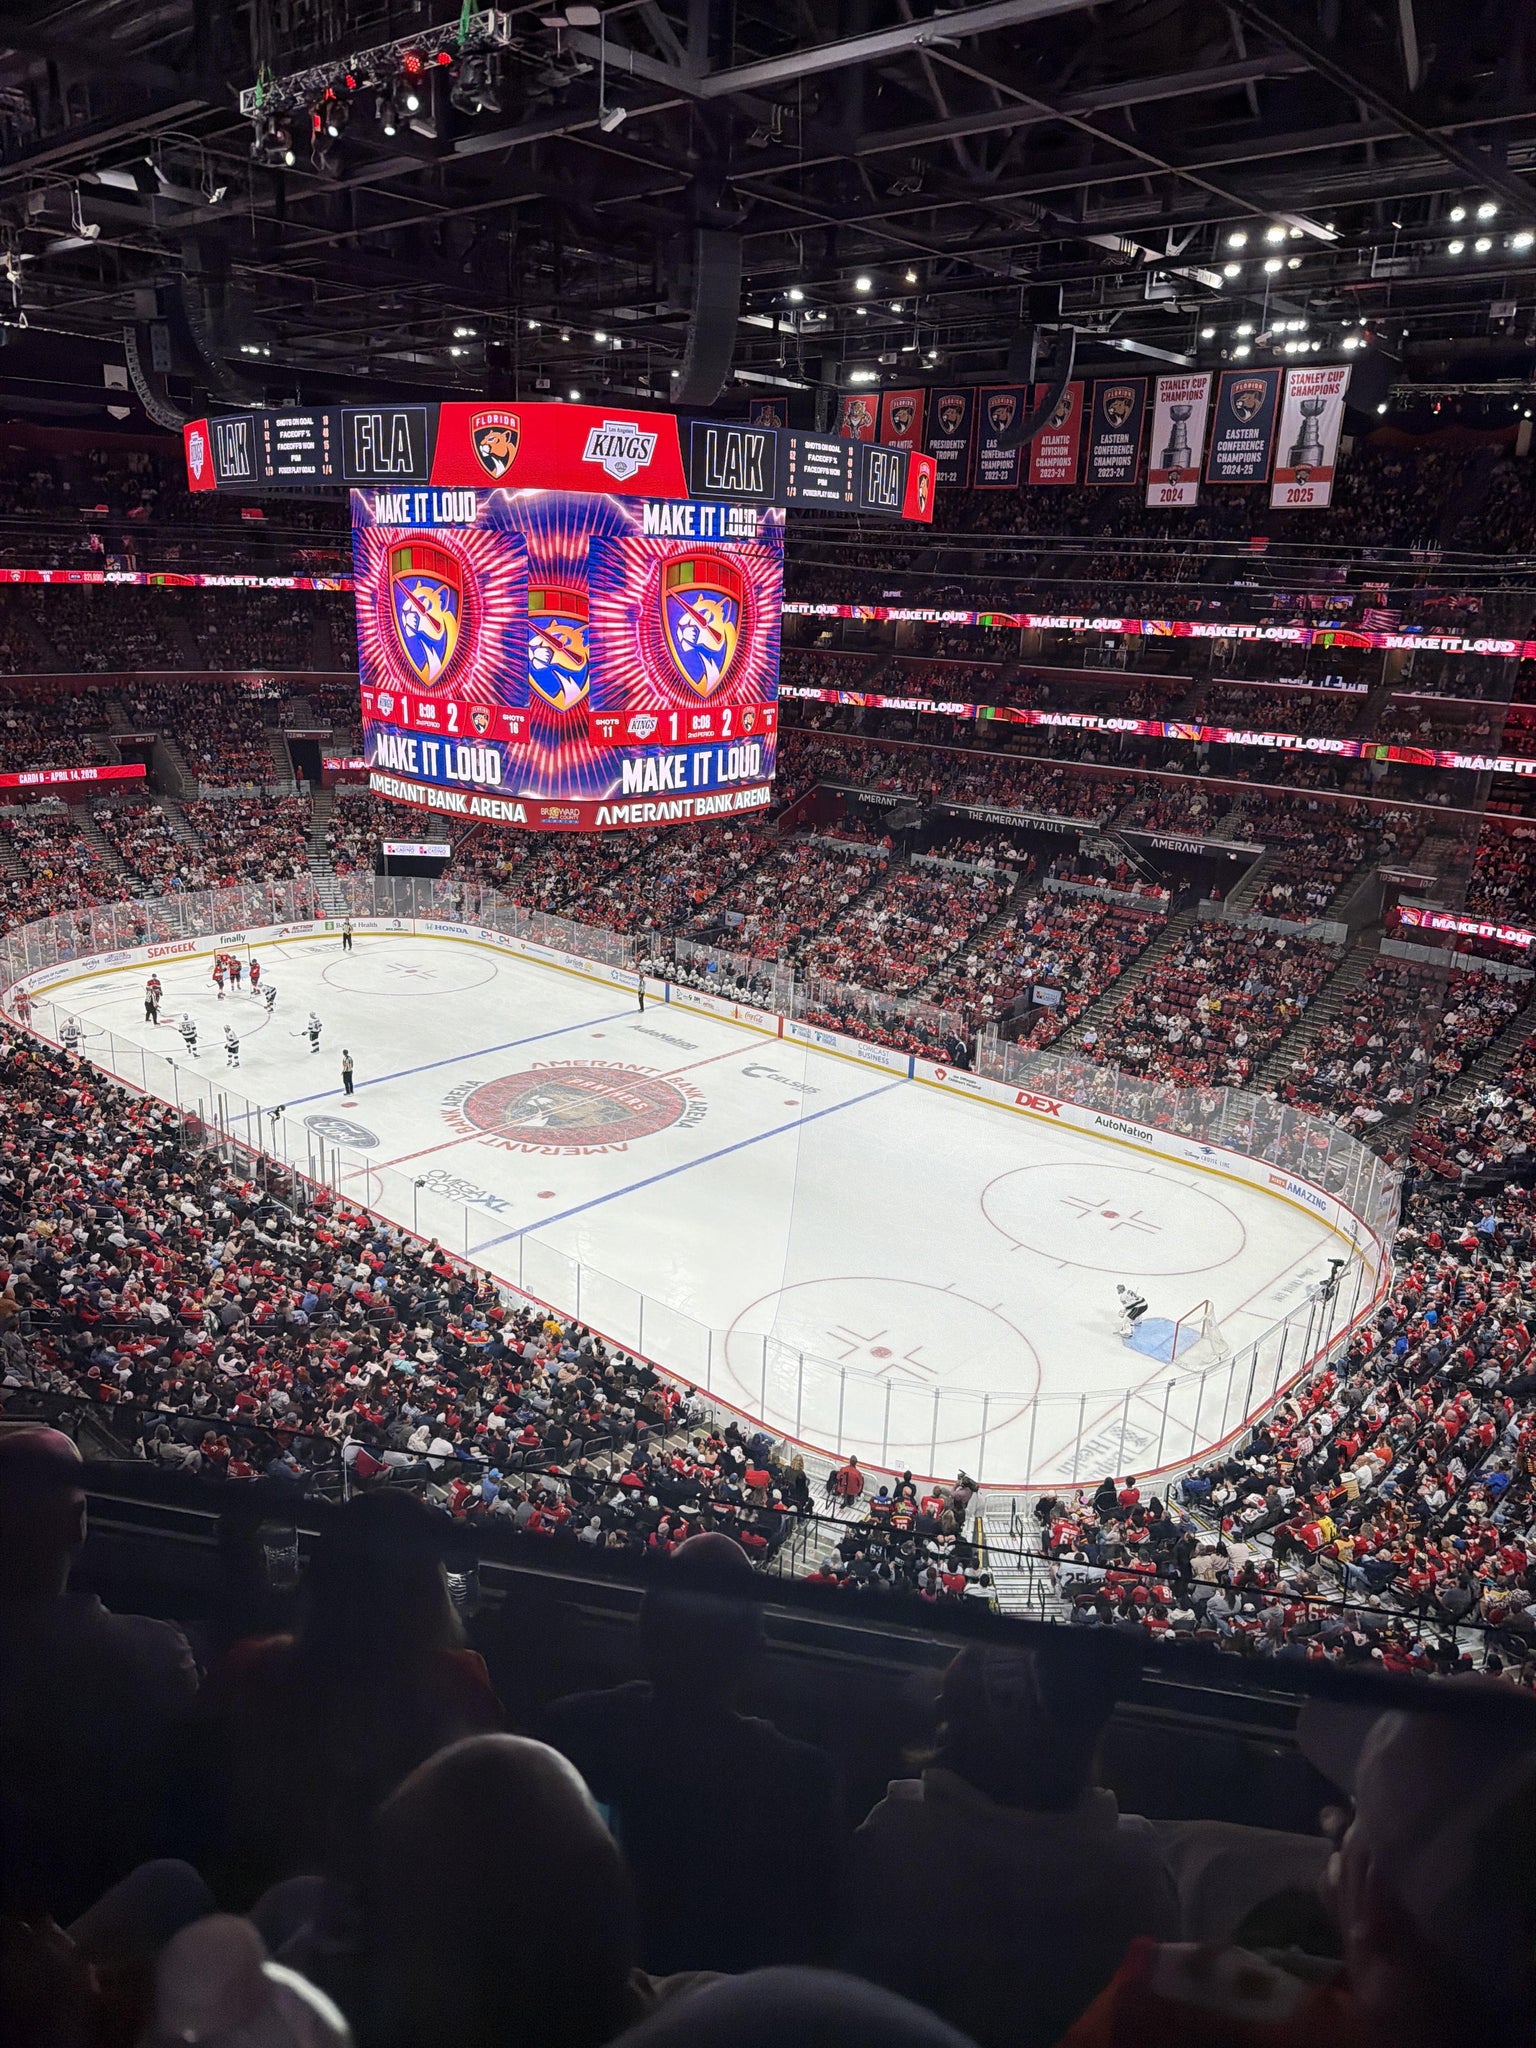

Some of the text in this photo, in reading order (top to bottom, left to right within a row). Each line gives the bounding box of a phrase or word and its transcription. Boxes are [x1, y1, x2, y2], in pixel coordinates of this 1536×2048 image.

[1160, 377, 1207, 392] STANLEY CUP
[1290, 371, 1344, 384] STANLEY CUP
[1233, 381, 1265, 392] FLORIDA
[1291, 384, 1340, 396] CHAMPIONS
[1160, 389, 1204, 402] CHAMPIONS
[475, 414, 516, 428] FLORIDA
[279, 430, 305, 439] FACEOFF
[1041, 435, 1070, 445] ATLANTIC
[1101, 434, 1129, 444] EASTERN
[1226, 428, 1259, 439] EASTERN
[217, 422, 250, 477] LAK
[354, 415, 413, 473] FLA
[592, 434, 650, 460] KINGS
[790, 438, 797, 449] 11
[1041, 445, 1068, 456] DIVISION
[1093, 444, 1134, 455] CONFERENCE
[1217, 440, 1265, 451] CONFERENCE
[705, 430, 765, 491] LAK
[807, 454, 833, 464] FACEOFF
[936, 450, 958, 460] TROPHY
[1036, 456, 1072, 467] CHAMPIONS
[1093, 455, 1131, 466] CHAMPIONS
[1217, 452, 1261, 463] CHAMPIONS
[322, 464, 333, 476] 1/4
[981, 460, 1014, 470] CHAMPIONS
[1221, 464, 1254, 475] 2024-25
[868, 451, 899, 506] FLA
[984, 470, 1008, 480] 2022-23
[1040, 468, 1065, 478] 2023-24
[1097, 467, 1124, 478] 2023-24
[1160, 488, 1184, 502] 2024
[1287, 488, 1314, 503] 2025
[375, 491, 476, 524] MAKE IT LOUD
[643, 503, 695, 536] MAKE
[700, 506, 717, 536] IT
[205, 575, 294, 588] MAKE IT LOUD
[798, 604, 809, 614] IT
[809, 604, 838, 615] LOUD
[888, 610, 968, 622] MAKE IT LOUD
[1029, 617, 1122, 630] MAKE IT LOUD
[1191, 625, 1300, 640] MAKE IT LOUD
[1386, 636, 1515, 653] MAKE IT LOUD
[793, 687, 821, 698] LOUD
[401, 695, 409, 724] 1
[418, 703, 436, 719] 8:08
[882, 697, 964, 713] MAKE IT LOUD
[447, 703, 459, 732] 2
[502, 713, 525, 722] SHOTS
[595, 718, 620, 726] SHOTS
[631, 719, 656, 730] KINGS
[692, 714, 711, 730] 8:08
[721, 709, 732, 737] 2
[1039, 713, 1139, 730] MAKE IT LOUD
[603, 725, 613, 738] 11
[669, 712, 678, 741] 1
[1225, 731, 1344, 751] MAKE IT LOUD
[376, 733, 501, 785] MAKE IT LOUD
[1453, 755, 1513, 772] MAKE
[621, 743, 761, 795] MAKE IT LOUD
[19, 773, 36, 784] CARDI
[50, 771, 71, 783] APRIL
[72, 770, 81, 781] 14,
[369, 771, 528, 824] AMERANT BANK ARENA
[858, 793, 897, 807] AMERANT
[595, 786, 771, 826] AMERANT BANK ARENA
[968, 811, 1066, 834] THE AMERANT VAULT
[1150, 838, 1205, 855] AMERANT
[434, 924, 469, 934] HONDA
[1432, 918, 1496, 936] MAKE IT
[220, 932, 246, 944] finally
[147, 940, 196, 959] SEATGEEK
[67, 1027, 76, 1036] 10
[182, 1024, 192, 1032] 55
[628, 1024, 699, 1051] AutoNation
[858, 1043, 890, 1057] COMCAST
[857, 1050, 890, 1065] BUSINESS
[767, 1070, 821, 1094] CELSIUS
[531, 1059, 710, 1129] AMERANT BANK ARENA
[565, 1077, 650, 1113] PANTHERS
[1015, 1091, 1063, 1117] DEX
[440, 1079, 629, 1157] AMERANT BANK ARENA
[313, 1121, 367, 1142] Ford
[1095, 1115, 1153, 1141] AutoNation
[1201, 1155, 1218, 1165] CRUISE
[426, 1168, 487, 1200] OMEGA
[481, 1193, 512, 1214] XL
[1287, 1182, 1327, 1211] AMAZING
[869, 1545, 883, 1556] 63
